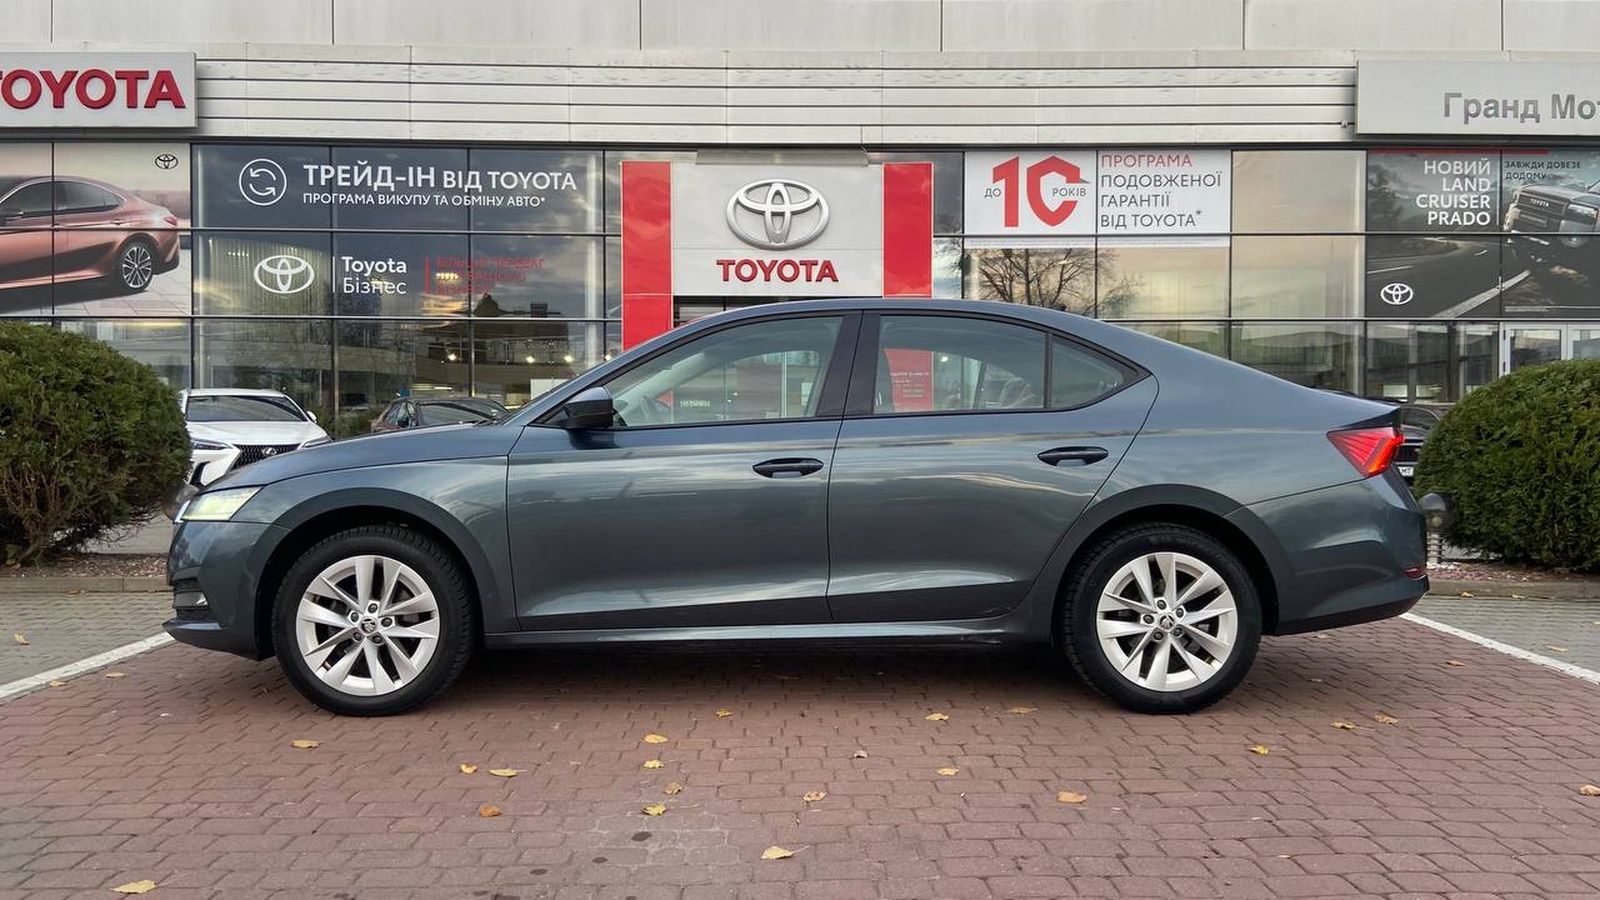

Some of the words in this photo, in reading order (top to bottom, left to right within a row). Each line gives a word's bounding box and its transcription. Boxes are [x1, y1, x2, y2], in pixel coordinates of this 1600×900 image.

[0, 69, 186, 110] OYOTA
[1444, 93, 1541, 124] Гранд
[1551, 94, 1600, 120] Мо
[1101, 154, 1192, 168] ПРОГРАМА
[1424, 158, 1491, 174] НОВИЙ
[1504, 161, 1545, 169] ЗАВЖДИ
[1546, 161, 1582, 169] ДОВЕЗЕ
[303, 161, 435, 191] ТРЕЙД-ІН
[443, 171, 482, 192] ВІД
[488, 172, 577, 191] TOYOTA
[1101, 171, 1222, 190] ПОДОВЖЕНОЇ
[1505, 172, 1547, 180] ДОДОМУ
[984, 188, 1002, 199] ДО
[1052, 187, 1087, 197] РОКІВ
[1442, 178, 1491, 192] LAND
[303, 193, 375, 206] ПРОГРАМА
[378, 193, 431, 206] ВИКУПУ
[432, 195, 449, 206] ТА
[451, 195, 504, 207] ОБМІНУ
[1101, 192, 1170, 208] ГАРАНТІЇ
[1416, 194, 1490, 209] CRUISER
[1100, 214, 1127, 230] ВІД
[1427, 211, 1490, 225] PRADO
[342, 256, 407, 277] Toyota
[716, 259, 839, 283] TOYOTA
[343, 277, 407, 295] Бізнес
